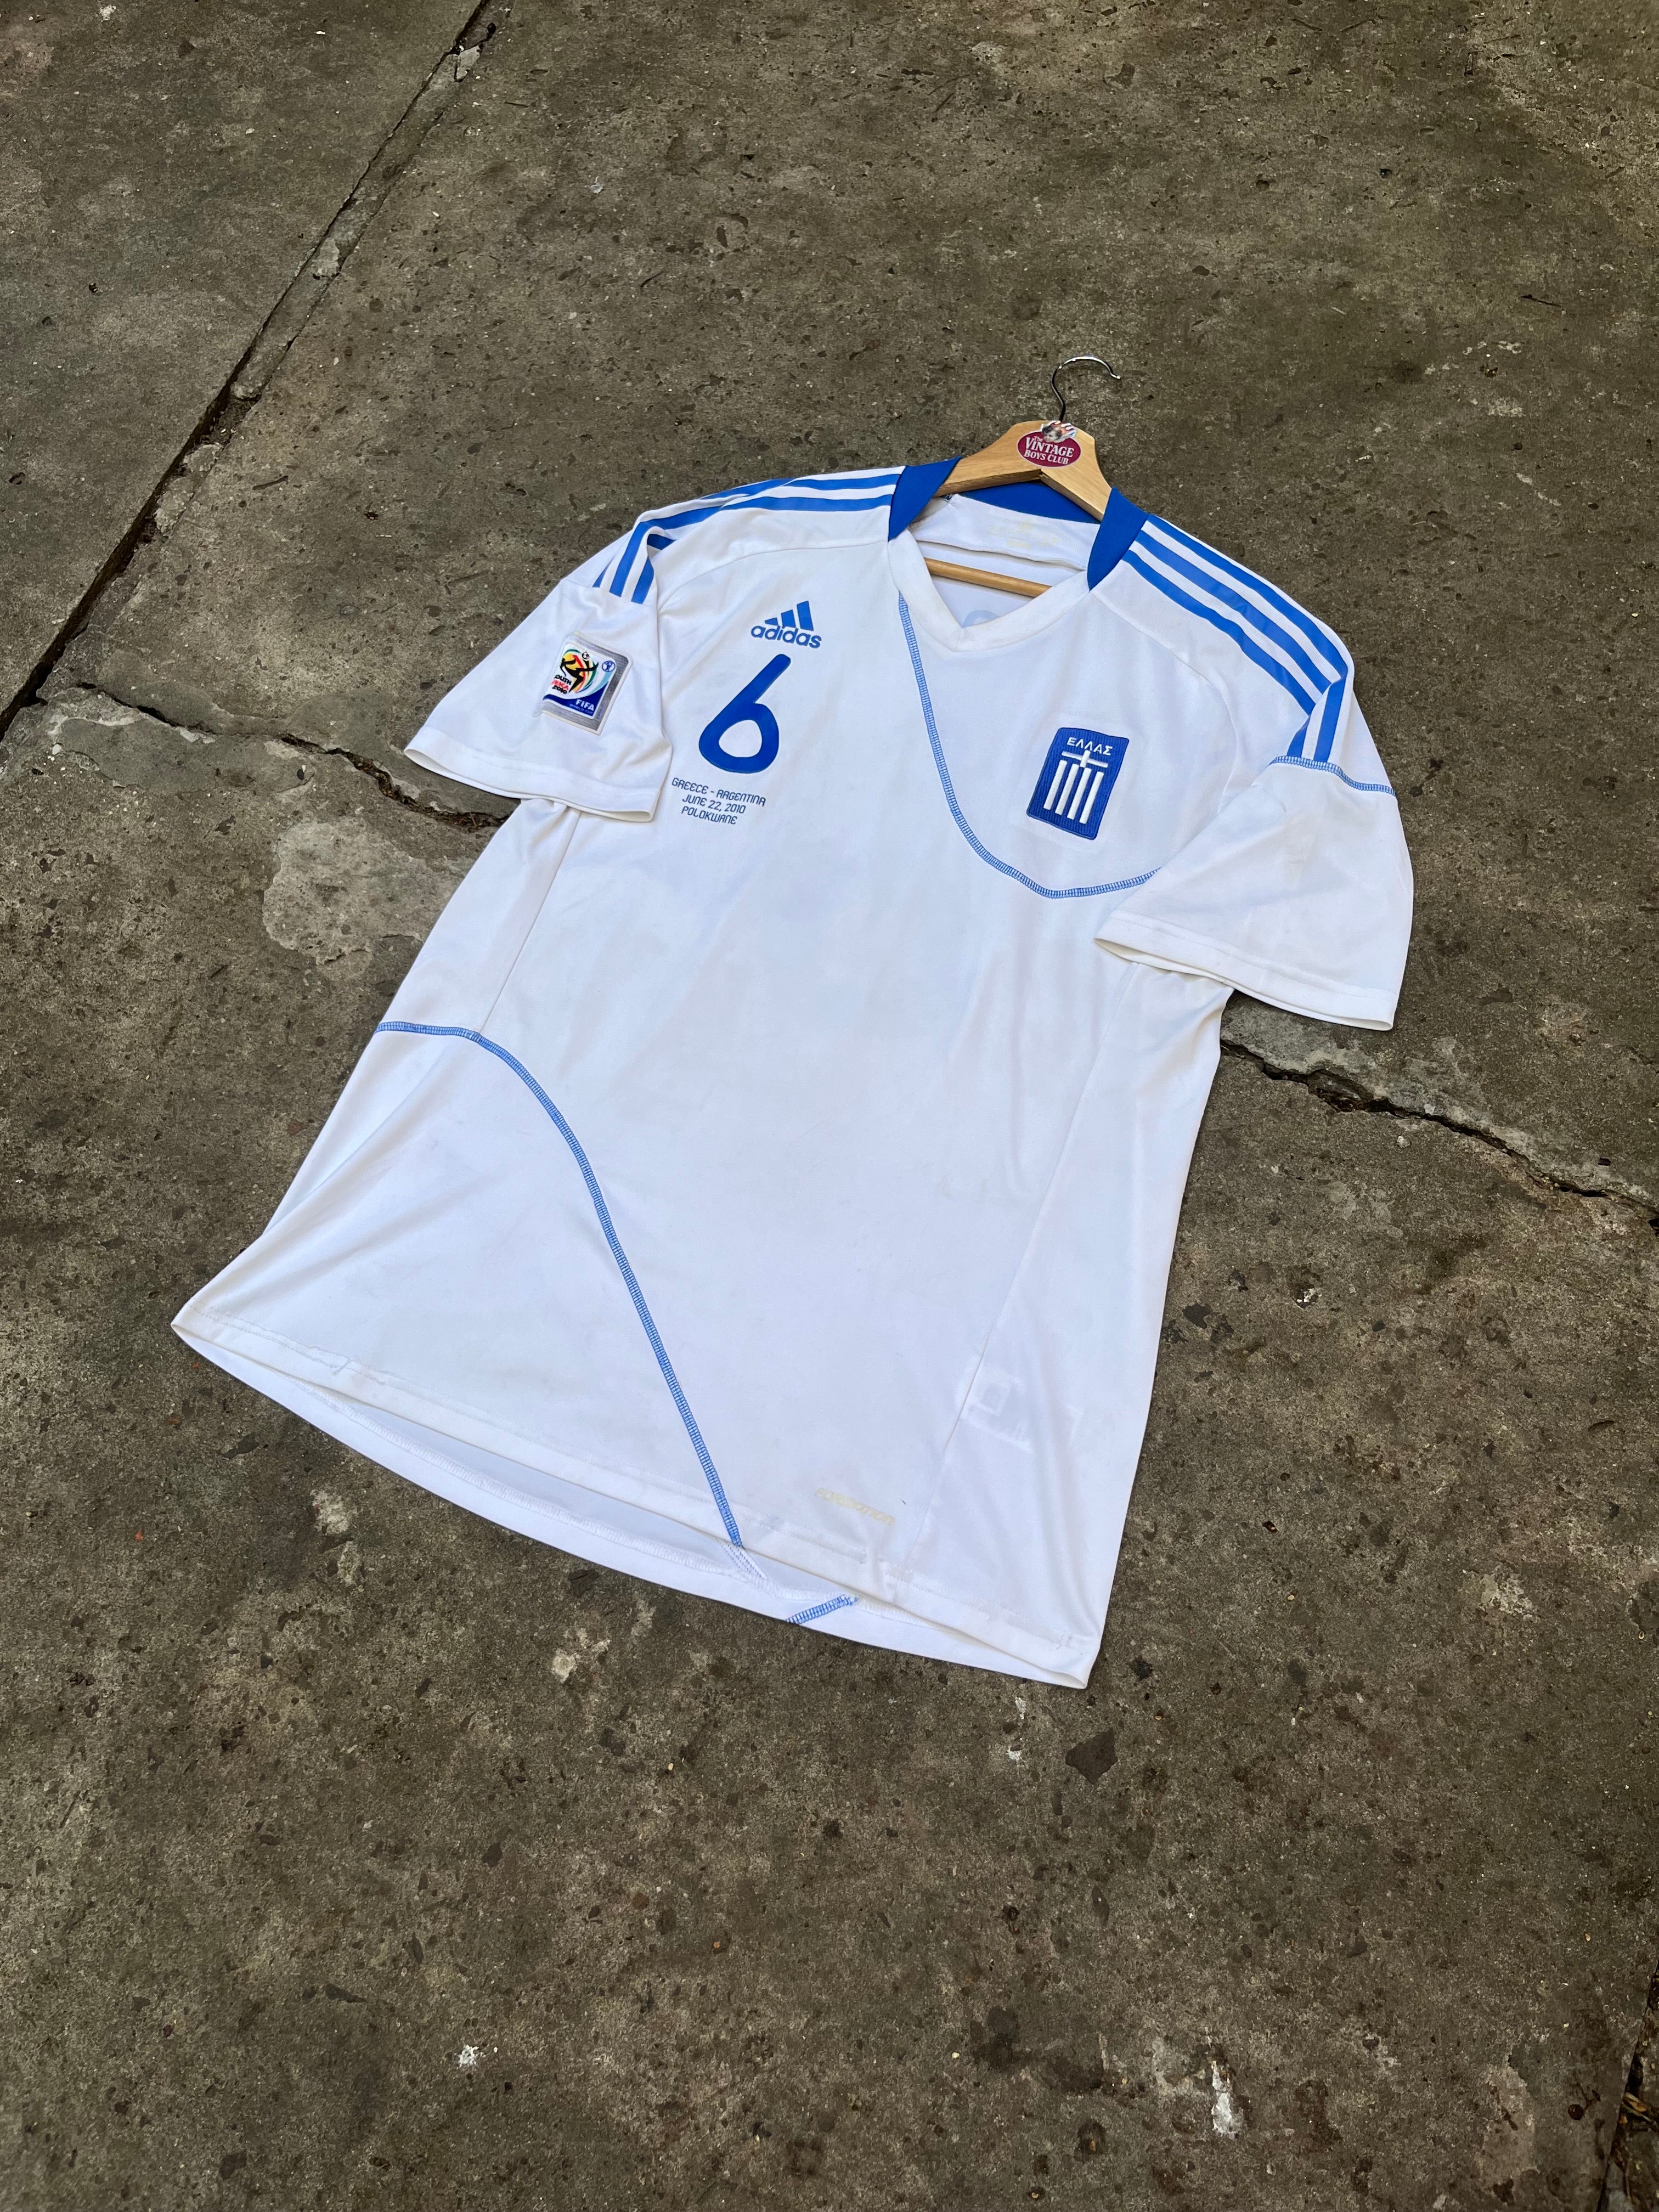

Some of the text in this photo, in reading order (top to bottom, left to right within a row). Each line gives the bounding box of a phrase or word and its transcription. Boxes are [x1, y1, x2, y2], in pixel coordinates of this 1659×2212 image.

[1024, 449, 1069, 465] BOYS CLUB
[1025, 437, 1075, 458] VINTAGE
[751, 625, 822, 648] adidas
[575, 698, 594, 711] FIFA
[698, 653, 791, 774] 6
[1066, 737, 1113, 756] ΕΛΛΑΣ
[672, 777, 709, 794] GREECE
[716, 789, 766, 807] ARGENTINA
[682, 794, 746, 814] JUNE 22, 2010
[681, 806, 738, 825] POLOKWANE
